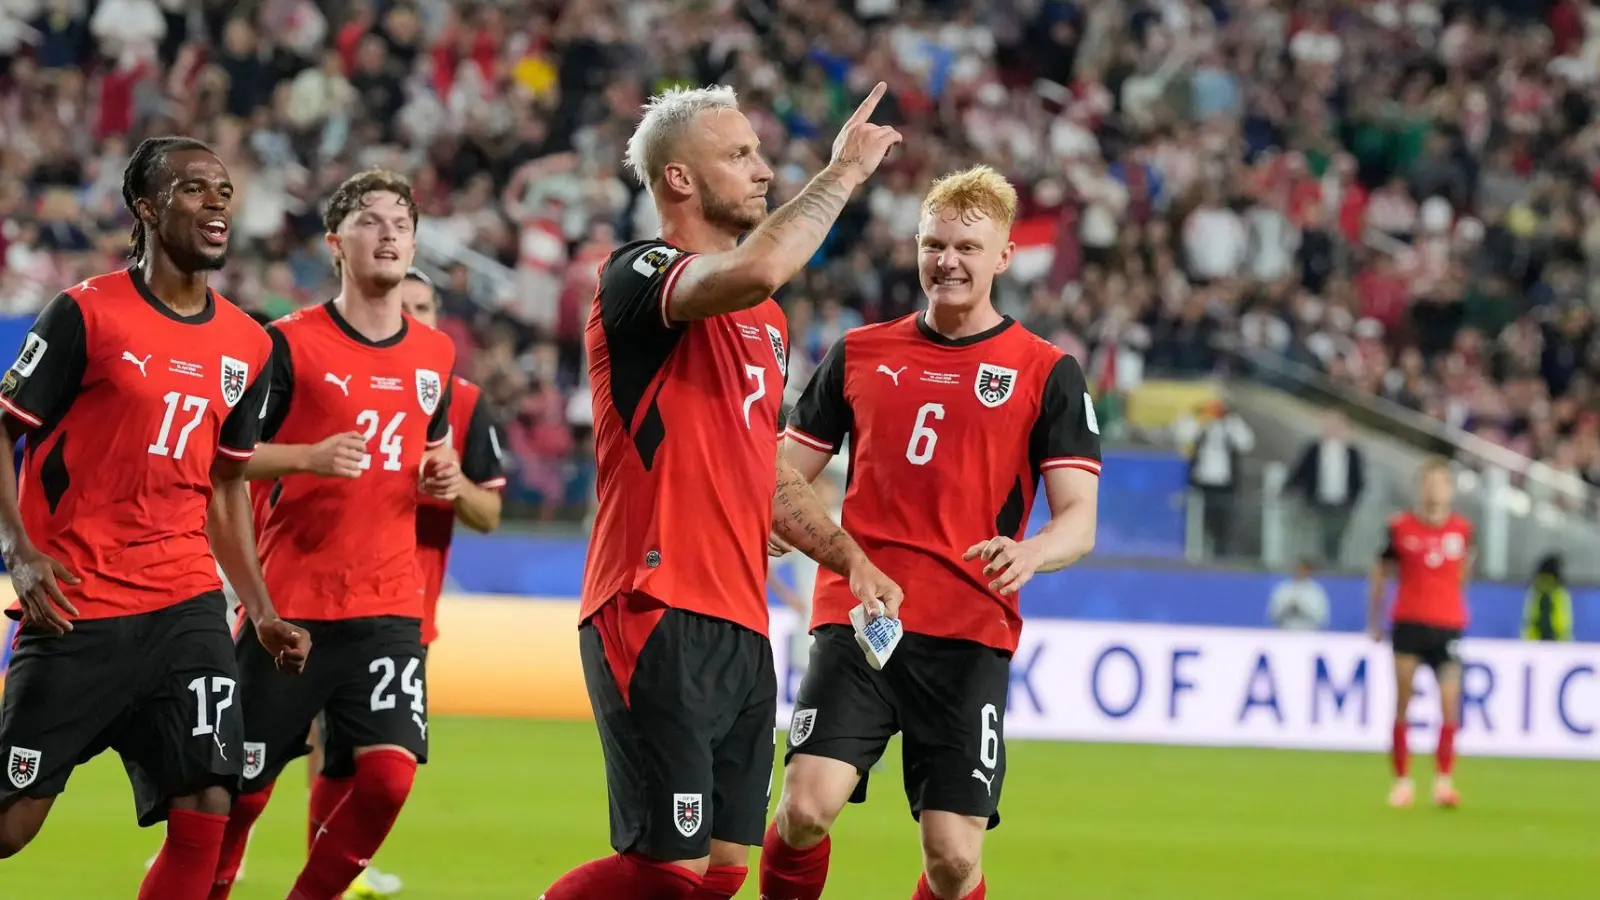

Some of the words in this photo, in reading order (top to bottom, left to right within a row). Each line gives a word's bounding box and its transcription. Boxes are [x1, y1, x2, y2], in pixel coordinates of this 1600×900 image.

[147, 391, 211, 460] 17
[743, 364, 766, 429] 7
[356, 409, 407, 471] 24
[906, 402, 946, 466] 6
[862, 622, 883, 653] FOOTBALL
[867, 616, 891, 648] UNITES
[187, 675, 237, 737] 17
[368, 655, 425, 713] 24
[1091, 645, 1202, 721] OF
[980, 702, 999, 769] 6
